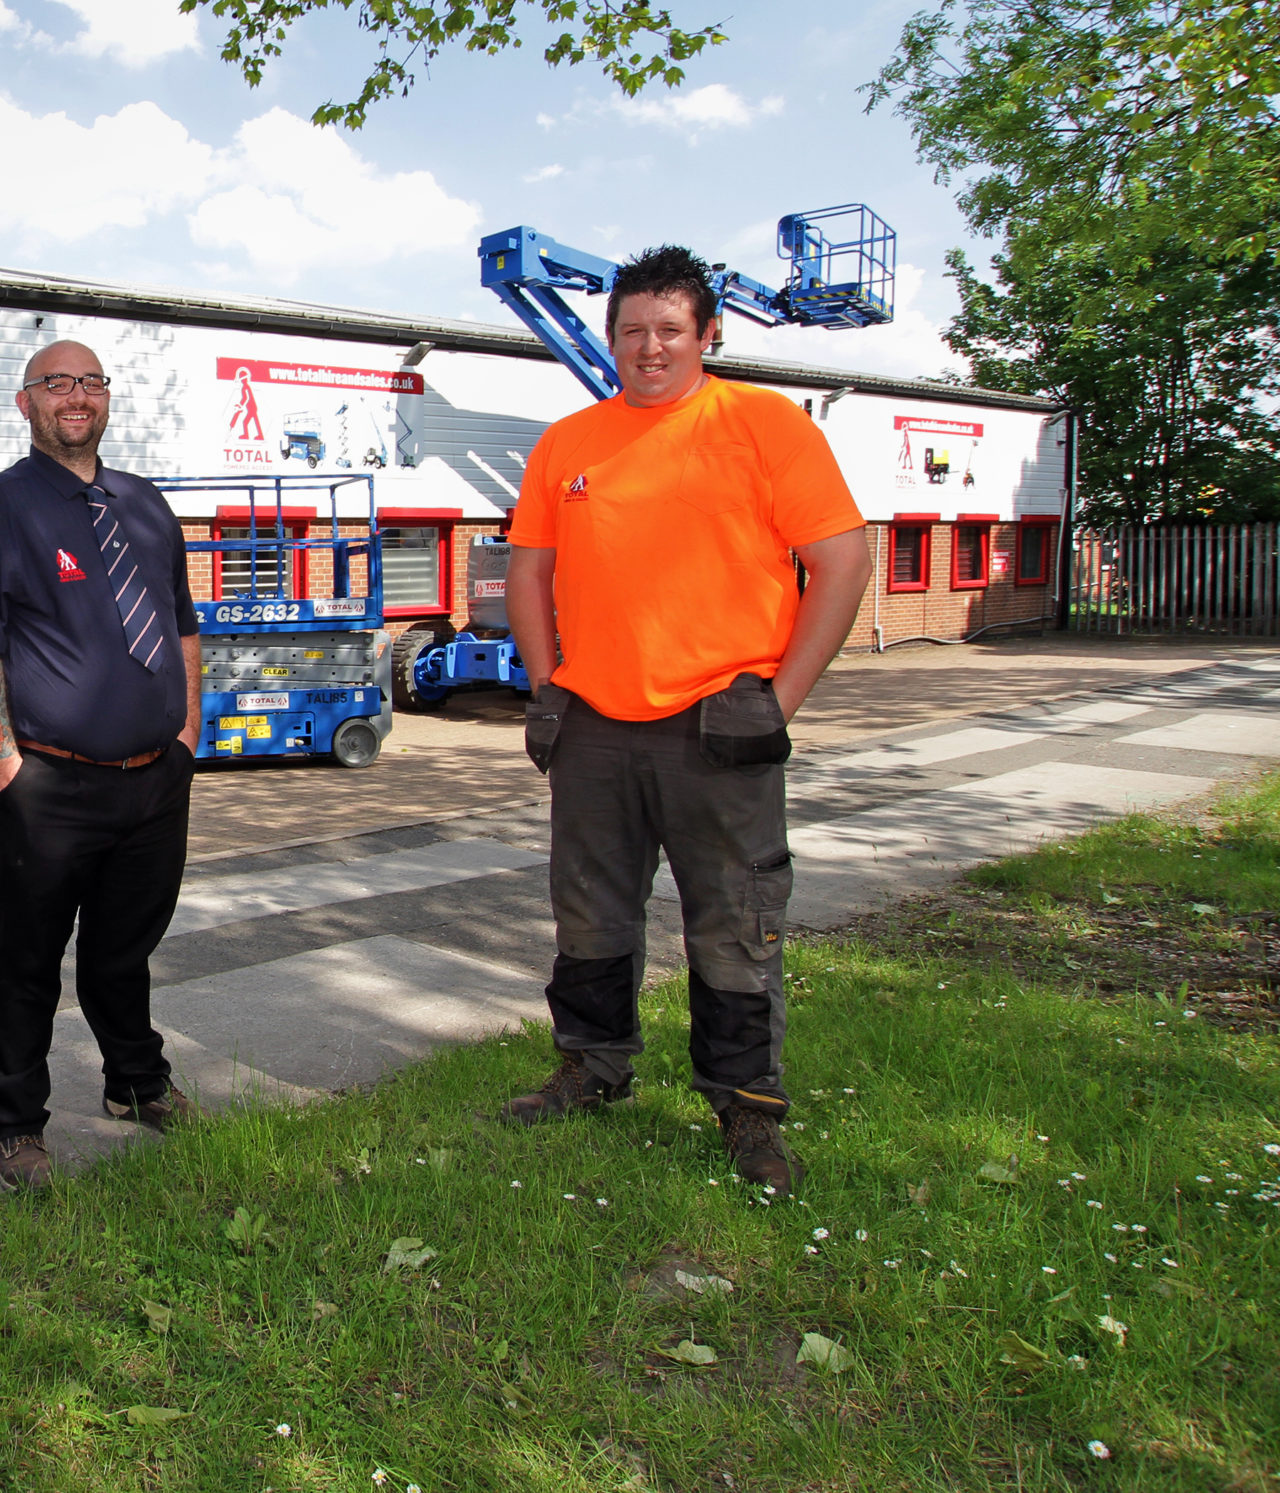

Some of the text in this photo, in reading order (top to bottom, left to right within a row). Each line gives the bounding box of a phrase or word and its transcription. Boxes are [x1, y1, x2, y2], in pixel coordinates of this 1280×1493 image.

[268, 367, 414, 391] www.totalhireandsales.co.uk
[223, 448, 273, 463] TOTAL
[485, 582, 506, 591] TOTA
[216, 603, 300, 624] GS-2632
[263, 668, 288, 676] CLEAR
